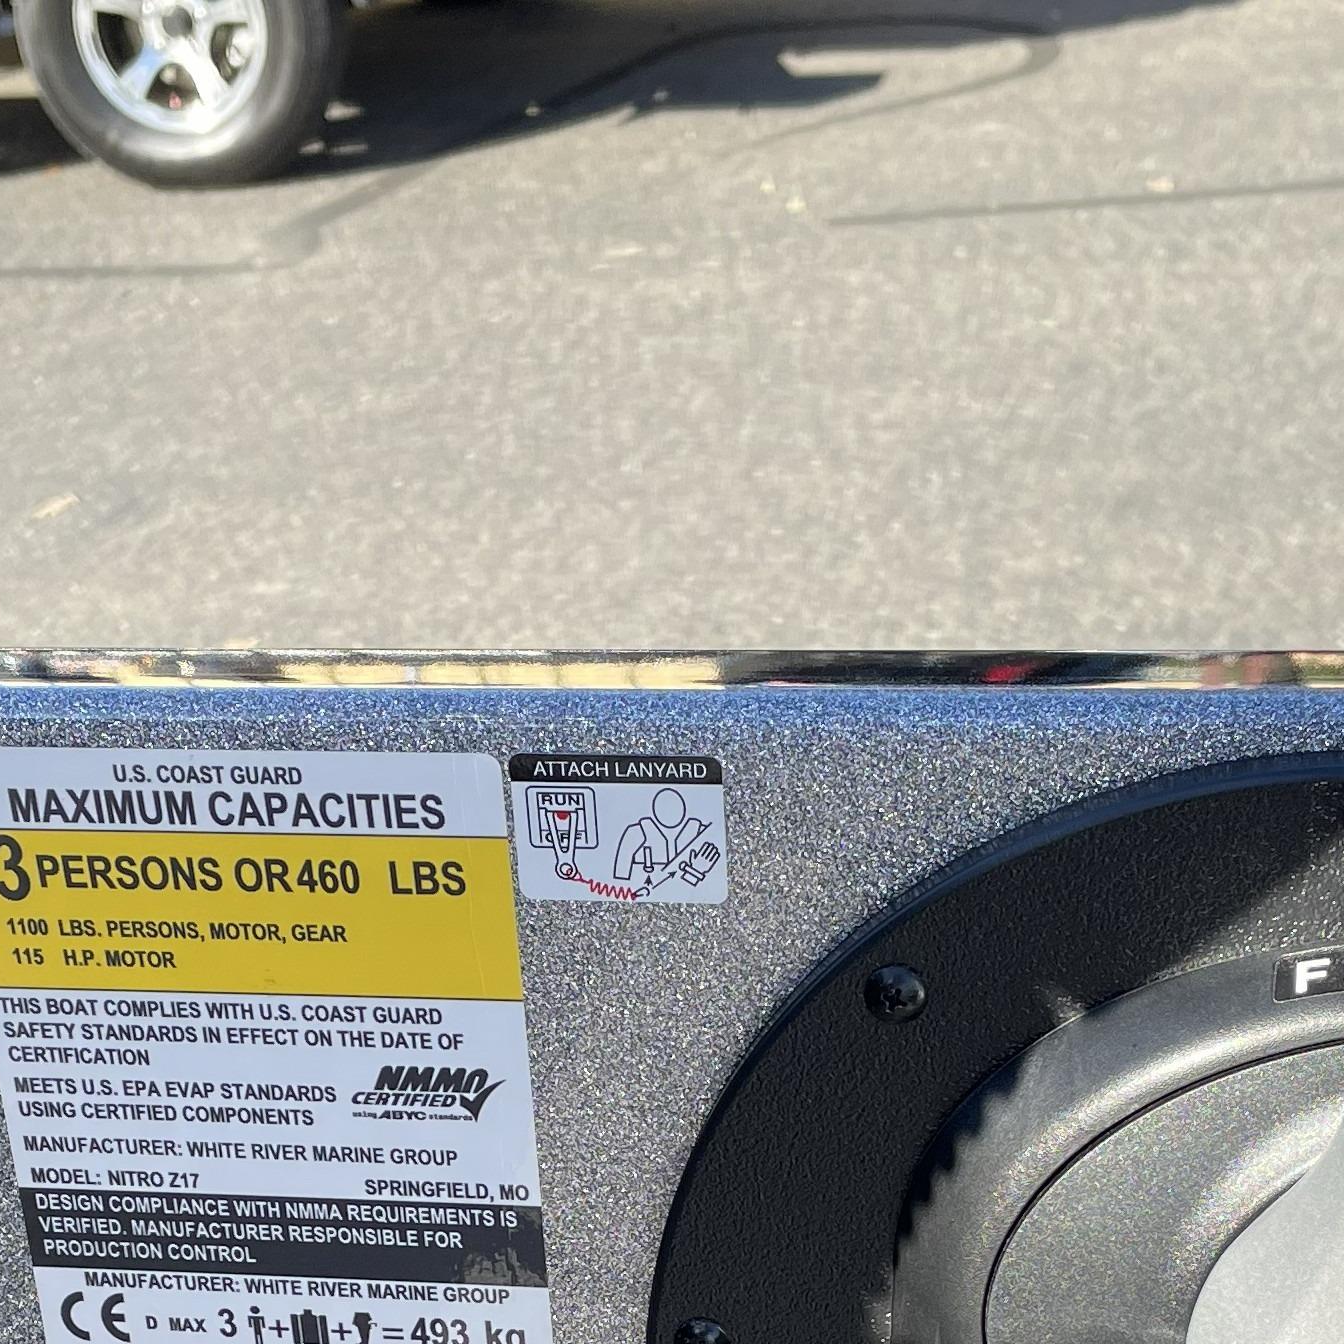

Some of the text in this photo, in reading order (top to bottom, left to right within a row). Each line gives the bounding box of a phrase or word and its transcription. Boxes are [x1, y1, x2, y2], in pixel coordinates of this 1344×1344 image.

[112, 764, 302, 785] U.S. COAST GUARD
[533, 761, 706, 778] ATTACH LANYARD
[7, 788, 445, 830] MAXIMUM CAPACITIES
[541, 795, 580, 806] RUN
[35, 854, 223, 892] PERSONS
[388, 860, 466, 896] LBS
[6, 917, 348, 944] 1100 LBS. PERSONS, MOTOR, GEAR
[12, 947, 177, 968] 115 H.P. MOTOR
[1295, 959, 1330, 993] F
[45, 998, 98, 1016] BOAT
[103, 999, 201, 1019] COMPLIES
[204, 1001, 254, 1020] WITH
[258, 1003, 296, 1021] U.S.
[301, 1004, 367, 1023] COAST
[372, 1006, 442, 1025] GUARD
[3, 1021, 464, 1050] SAFETY STANDARDS IN EFFECT ON THE DATE OF
[8, 1045, 150, 1066] CERTIFICATION
[13, 1076, 337, 1103] MEETS U.S. EPA EVAP STANDARDS
[351, 1091, 458, 1107] CERTIFIED
[17, 1100, 314, 1126] USING CERTIFIED COMPONENTS
[378, 1110, 427, 1121] ABYC
[22, 1135, 458, 1166] MANUFACTURER: WHITE RIVER MARINE GROUP
[30, 1167, 199, 1188] MODEL: NITRO Z17
[364, 1178, 529, 1203] SPRINGFIELD, MO
[35, 1193, 517, 1228] DESIGN COMPLIANCE WITH NMMA REQUIREMENTS IS
[37, 1215, 463, 1248] VERIFIED. MANUFACTURER RESPONSIBLE FOR
[43, 1238, 257, 1263] PRODUCTION CONTROL
[83, 1271, 510, 1304] MANUFACTURER: WHITE RIVER MARINE GROUP
[145, 1315, 158, 1330] D
[168, 1316, 207, 1333] MAX
[217, 1308, 237, 1337] 3
